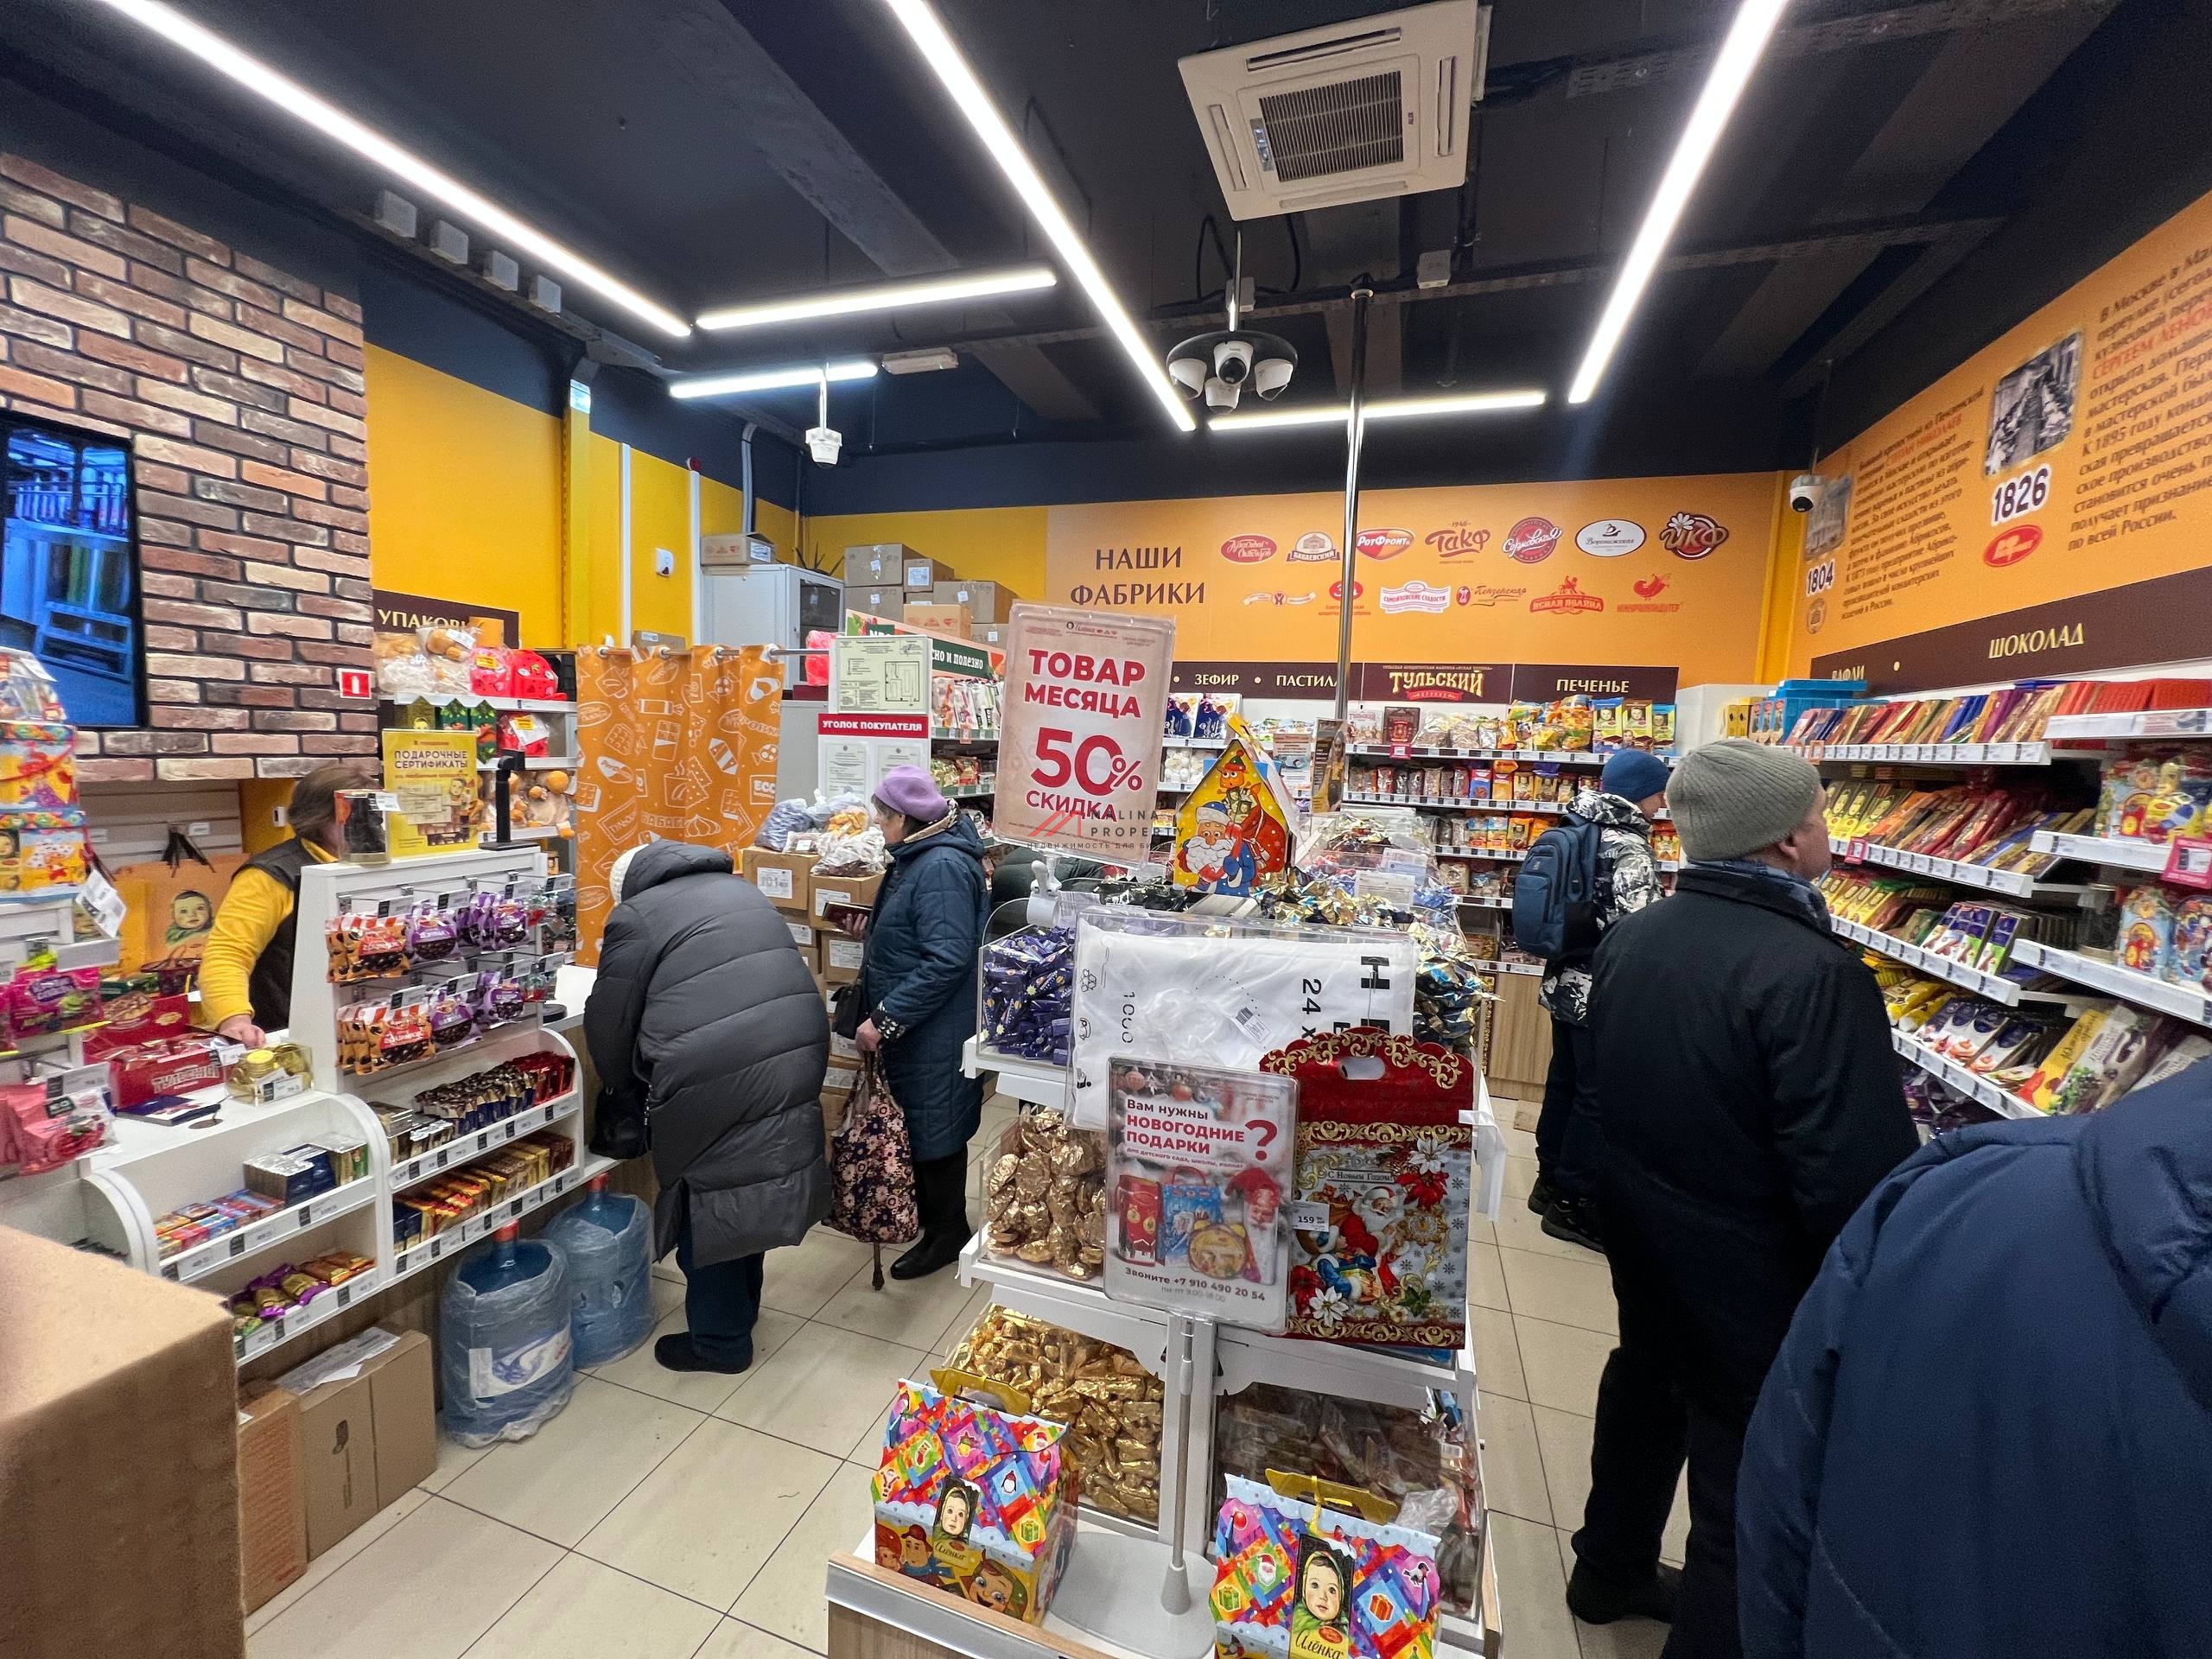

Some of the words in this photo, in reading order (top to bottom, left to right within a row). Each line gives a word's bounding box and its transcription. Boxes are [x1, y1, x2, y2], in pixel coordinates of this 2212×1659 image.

[2094, 427, 2126, 450] 1895
[1992, 467, 2050, 524] 1826
[1095, 546, 1182, 571] НАШИ
[1293, 550, 1336, 561] БАБАЕВСКИЙ
[1807, 560, 1834, 595] 1804
[1070, 581, 1205, 607] ФАБРИКИ
[1989, 622, 2085, 660] ШОКОЛАД
[1028, 649, 1147, 688] ТОВАР
[1194, 672, 1240, 687] ЗЕФИР
[1276, 675, 1338, 687] ПАСТИЛ
[1389, 670, 1484, 697] ТУЛЬСКИЙ
[1556, 678, 1630, 694] ПЕЧЕНЬЕ
[1024, 682, 1142, 719] МЕСЯЦА
[823, 719, 859, 730] УГОЛОК
[860, 721, 923, 733] ПОКУПАТЕЛЯ
[394, 750, 468, 760] ПОДАРОЧНЫЕ
[394, 760, 468, 769] СЕРТИФИКАТЫ
[1026, 790, 1118, 823] СКИДКА
[1127, 1098, 1154, 1113] Вам
[1159, 1105, 1209, 1121] нужны
[1126, 1114, 1245, 1143] НОВОГОДНИЕ
[1244, 1119, 1279, 1161] ?
[1126, 1130, 1211, 1155] ПОДАРКИ
[1140, 1150, 1172, 1160] детского
[1298, 1215, 1315, 1224] 159
[1125, 1267, 1171, 1285] Звоните
[1189, 1279, 1208, 1289] 910
[1211, 1282, 1231, 1294] 490
[1235, 1287, 1249, 1298] 20
[1251, 1291, 1266, 1301] 54
[1295, 1628, 1344, 1659] Алёнка
